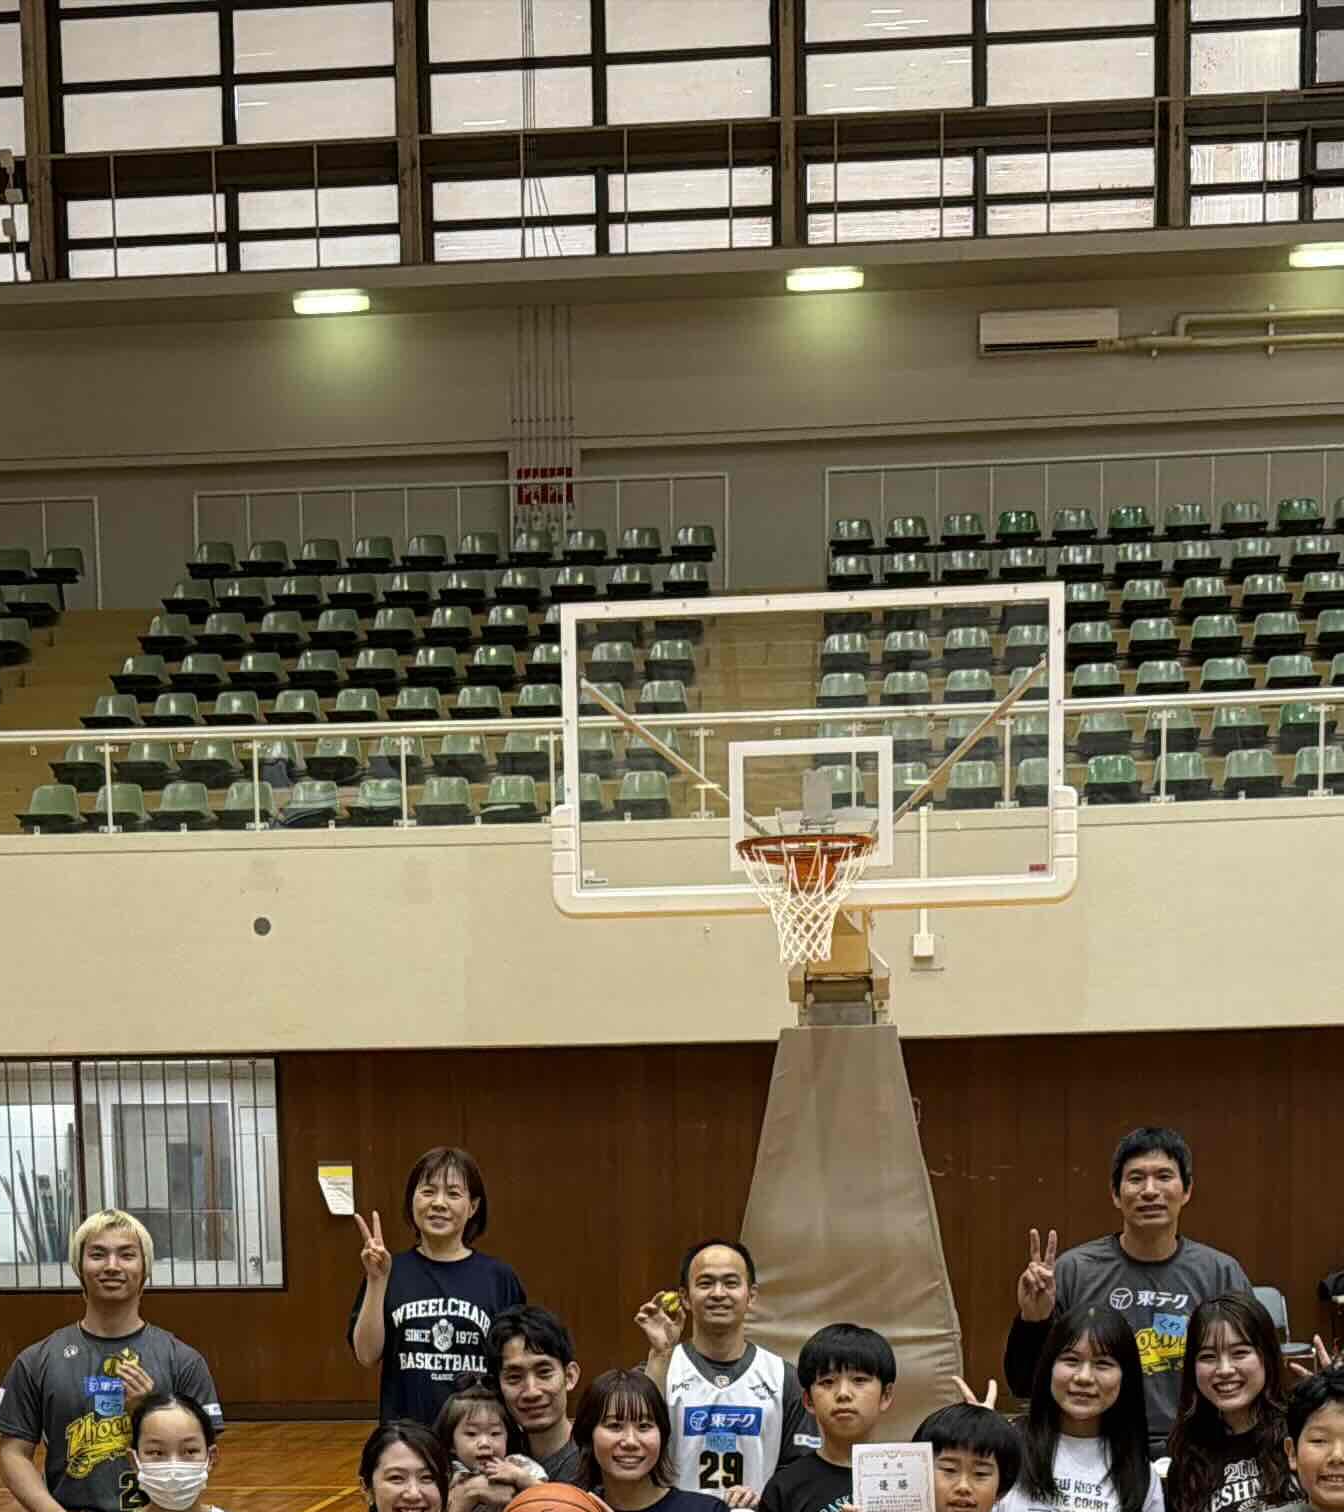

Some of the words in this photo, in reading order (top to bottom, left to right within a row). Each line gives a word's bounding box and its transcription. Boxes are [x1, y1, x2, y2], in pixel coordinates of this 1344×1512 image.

[1136, 1290, 1189, 1309] 東テク
[392, 1298, 491, 1338] WHEELCHAIR
[404, 1329, 431, 1342] SINCE
[455, 1330, 480, 1344] 1975
[398, 1352, 488, 1373] BASKETBALL
[710, 1413, 756, 1428] 東テク
[699, 1451, 744, 1489] 29
